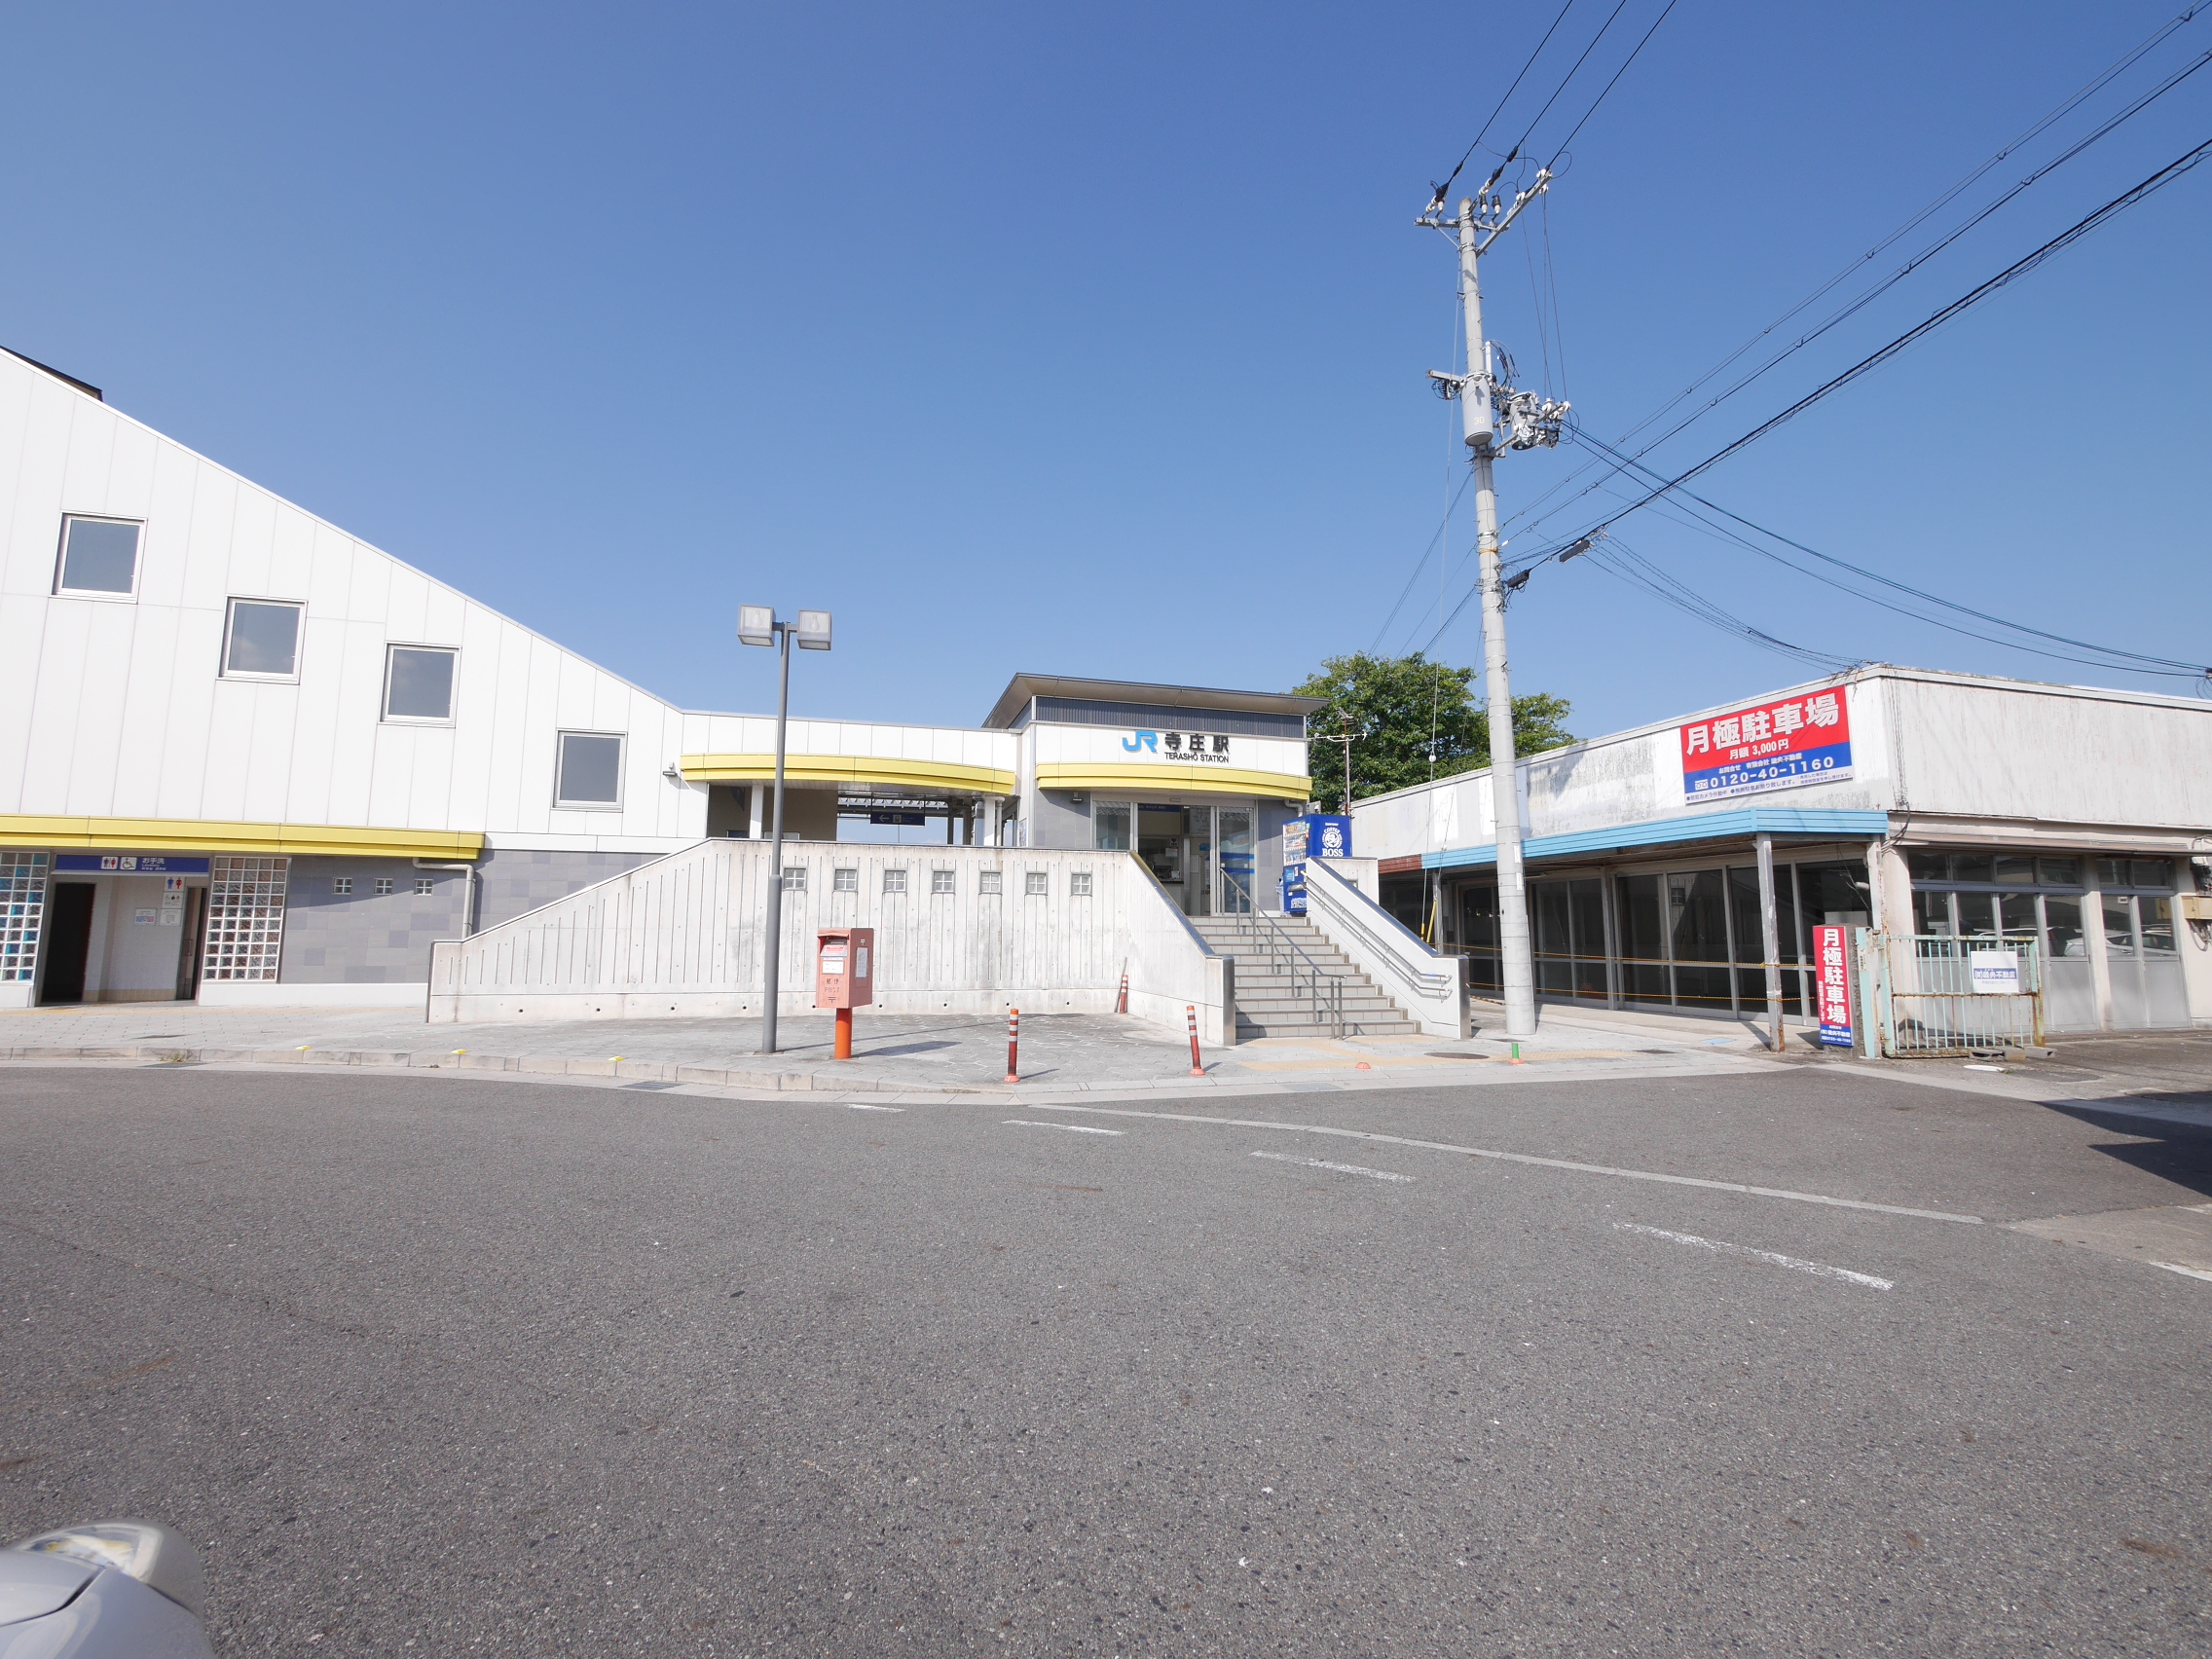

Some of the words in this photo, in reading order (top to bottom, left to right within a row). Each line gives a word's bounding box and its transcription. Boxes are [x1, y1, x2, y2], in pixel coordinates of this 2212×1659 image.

[1686, 692, 1839, 756] 月極駐車場
[1122, 730, 1158, 754] JR
[1164, 732, 1230, 753] 寺庄駅
[1200, 755, 1229, 763] STATION
[1710, 756, 1834, 788] 0120-40-1160
[1321, 848, 1344, 857] BOSS
[1823, 928, 1847, 1024] 月極駐車場
